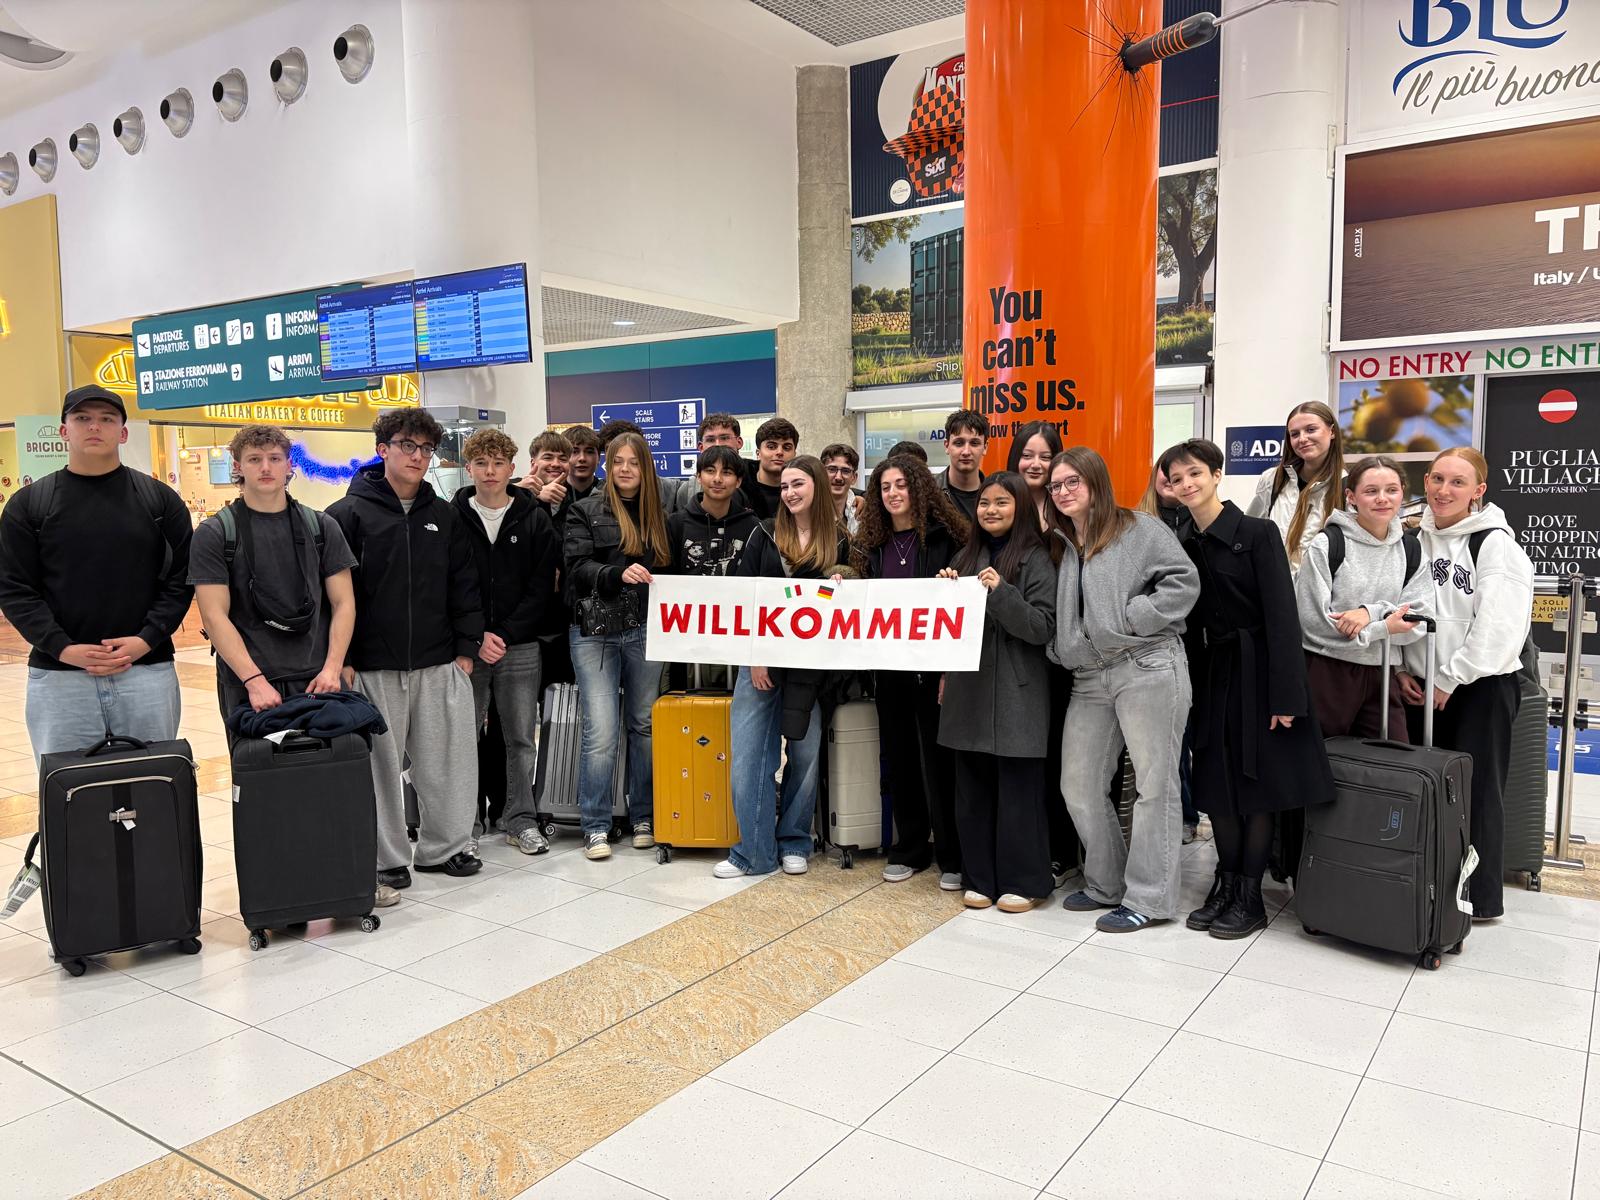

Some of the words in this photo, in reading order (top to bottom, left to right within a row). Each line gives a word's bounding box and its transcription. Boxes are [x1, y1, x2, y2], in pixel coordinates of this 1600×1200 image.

[1402, 70, 1433, 111] Il
[1431, 61, 1498, 114] più
[1534, 270, 1574, 285] Italy
[989, 286, 1042, 325] You
[152, 329, 183, 344] PARTENZE
[153, 341, 190, 355] DEPARTURES
[288, 352, 312, 367] ARRIVI
[1485, 347, 1530, 370] NO
[1541, 343, 1600, 367] ENT
[155, 366, 184, 380] STAZIONE
[185, 362, 228, 377] FERROVIARIA
[288, 365, 320, 379] ARRIVALS
[1340, 358, 1380, 380] NO
[1389, 350, 1472, 376] ENTRY
[155, 380, 180, 392] RAILWAY
[181, 377, 208, 389] STATION
[970, 377, 1028, 415] miss
[1036, 380, 1085, 412] us.
[207, 404, 252, 419] ITALIAN
[256, 405, 297, 422] BAKERY
[300, 408, 306, 421] &
[311, 408, 345, 423] COFFEE
[635, 409, 653, 417] SCALE
[635, 415, 654, 423] STAIRS
[930, 429, 946, 441] AD
[1249, 439, 1285, 457] AD
[1509, 449, 1600, 467] PUGLIA
[1520, 486, 1543, 494] LAND
[1551, 486, 1588, 494] FASHION
[1528, 514, 1577, 528] DOVE
[1520, 529, 1600, 543] SHOPPIN
[1522, 545, 1548, 558] UN
[1551, 545, 1600, 559] ALTR
[1533, 561, 1580, 575] ITMO
[660, 603, 965, 640] WILLKOMMEN
